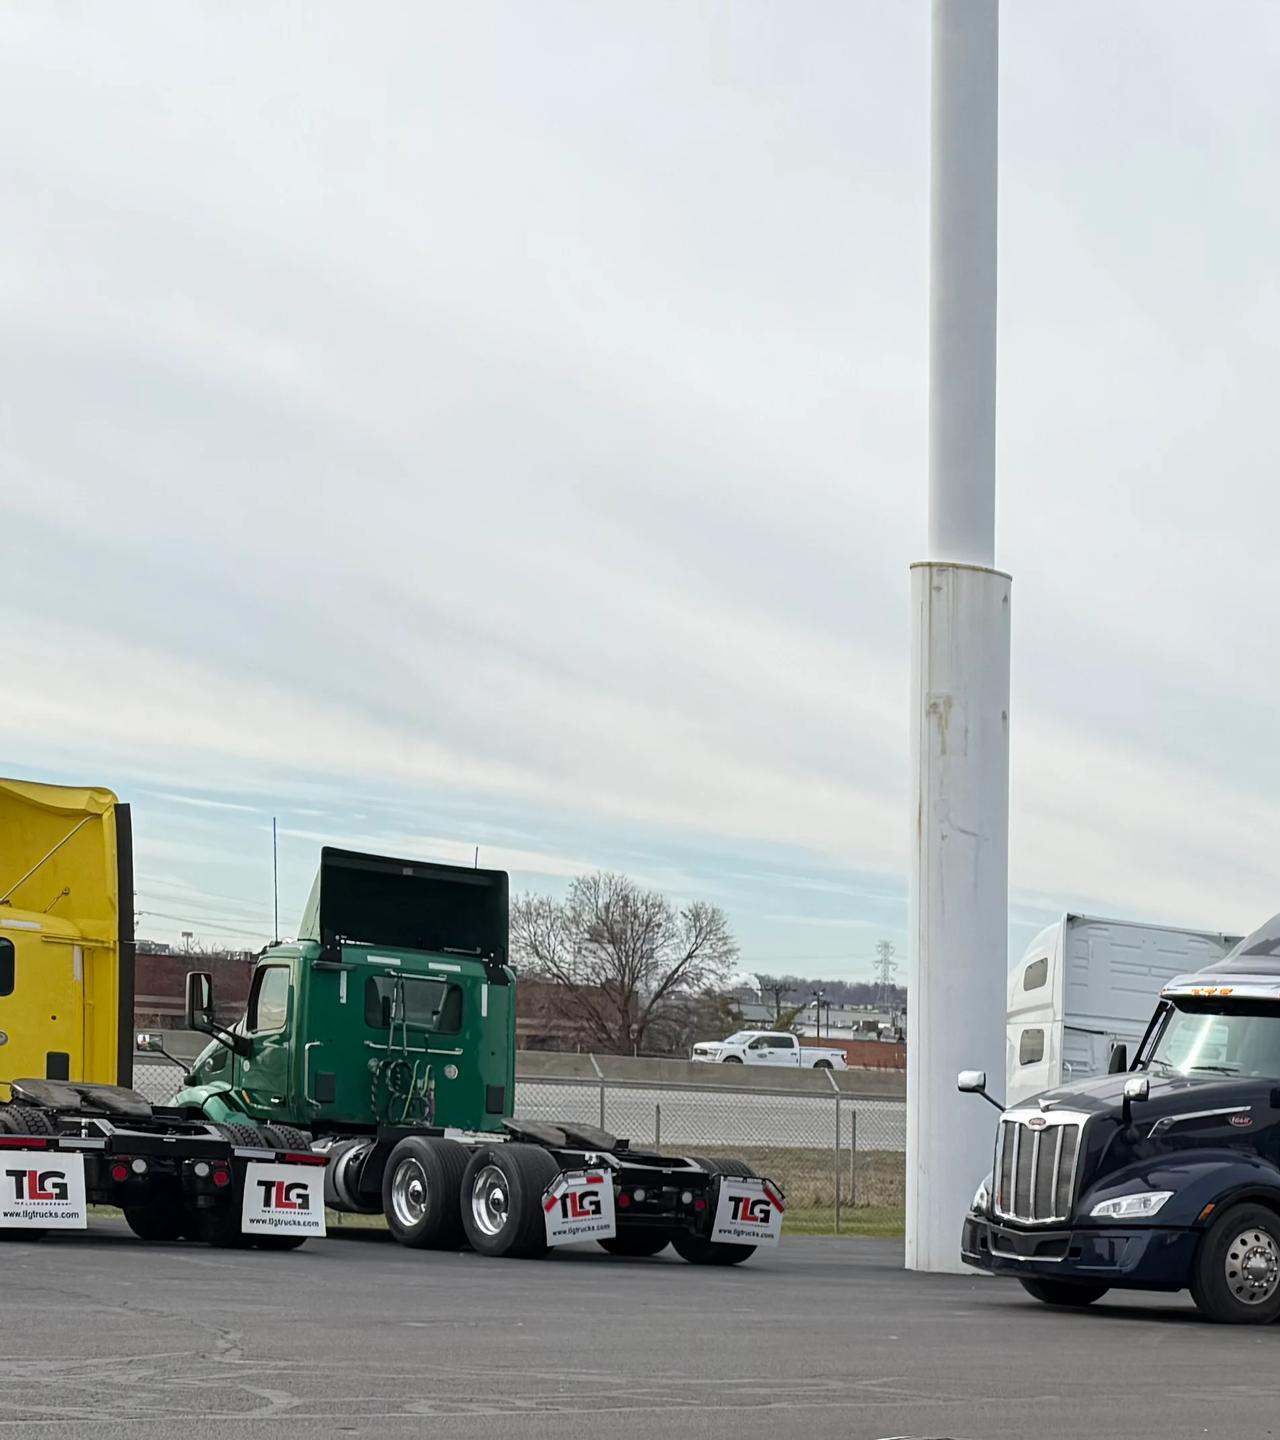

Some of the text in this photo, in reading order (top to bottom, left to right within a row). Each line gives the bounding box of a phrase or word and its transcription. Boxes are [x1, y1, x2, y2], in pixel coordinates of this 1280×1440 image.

[5, 1169, 69, 1200] TLG
[257, 1180, 310, 1210] TLG
[3, 1210, 80, 1220] www.tlgtrucks.com
[560, 1191, 602, 1219] TLG
[728, 1196, 771, 1224] TLG
